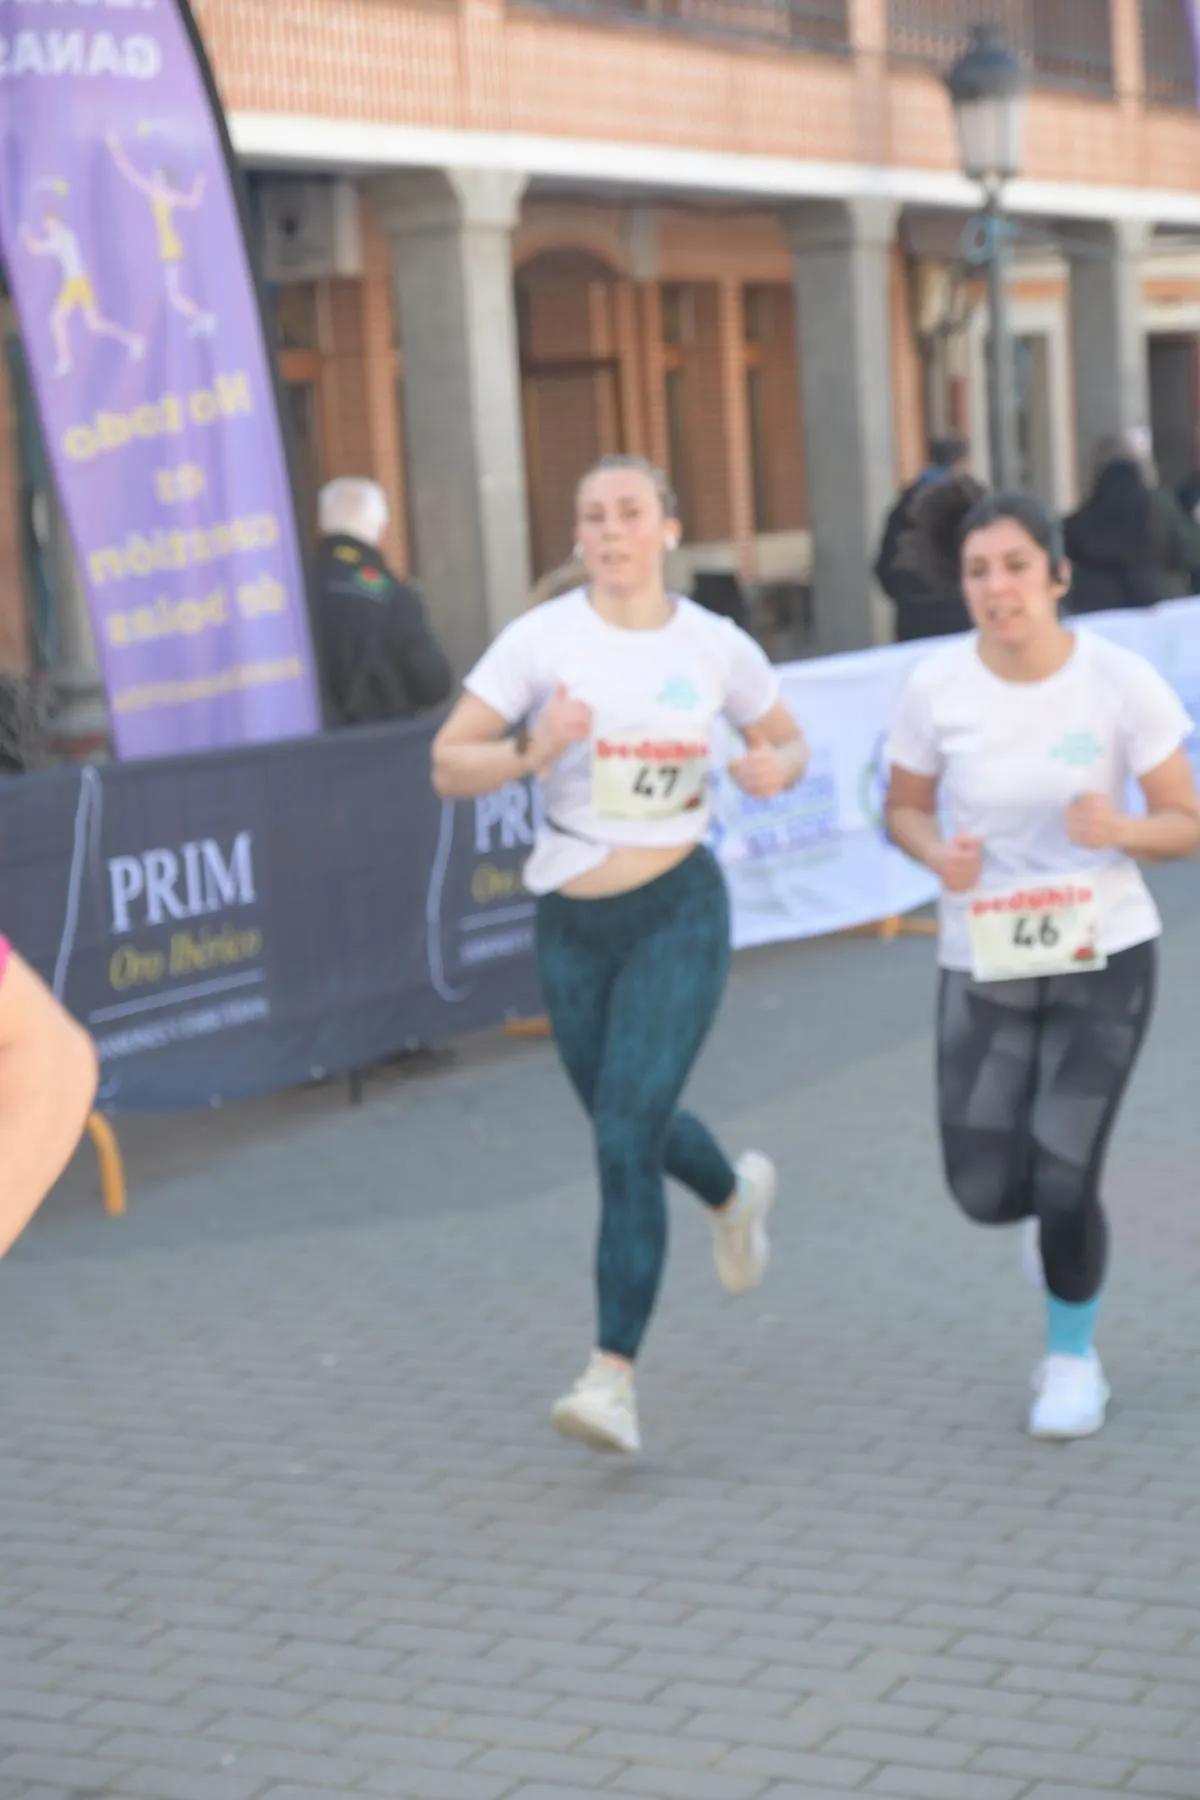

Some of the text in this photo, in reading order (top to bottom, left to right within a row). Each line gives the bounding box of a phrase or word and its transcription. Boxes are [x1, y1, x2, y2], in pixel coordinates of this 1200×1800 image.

[632, 765, 681, 799] 47
[474, 778, 548, 853] PRI
[108, 829, 257, 934] PRIM
[1012, 914, 1060, 948] 46
[109, 944, 166, 990] Oro
